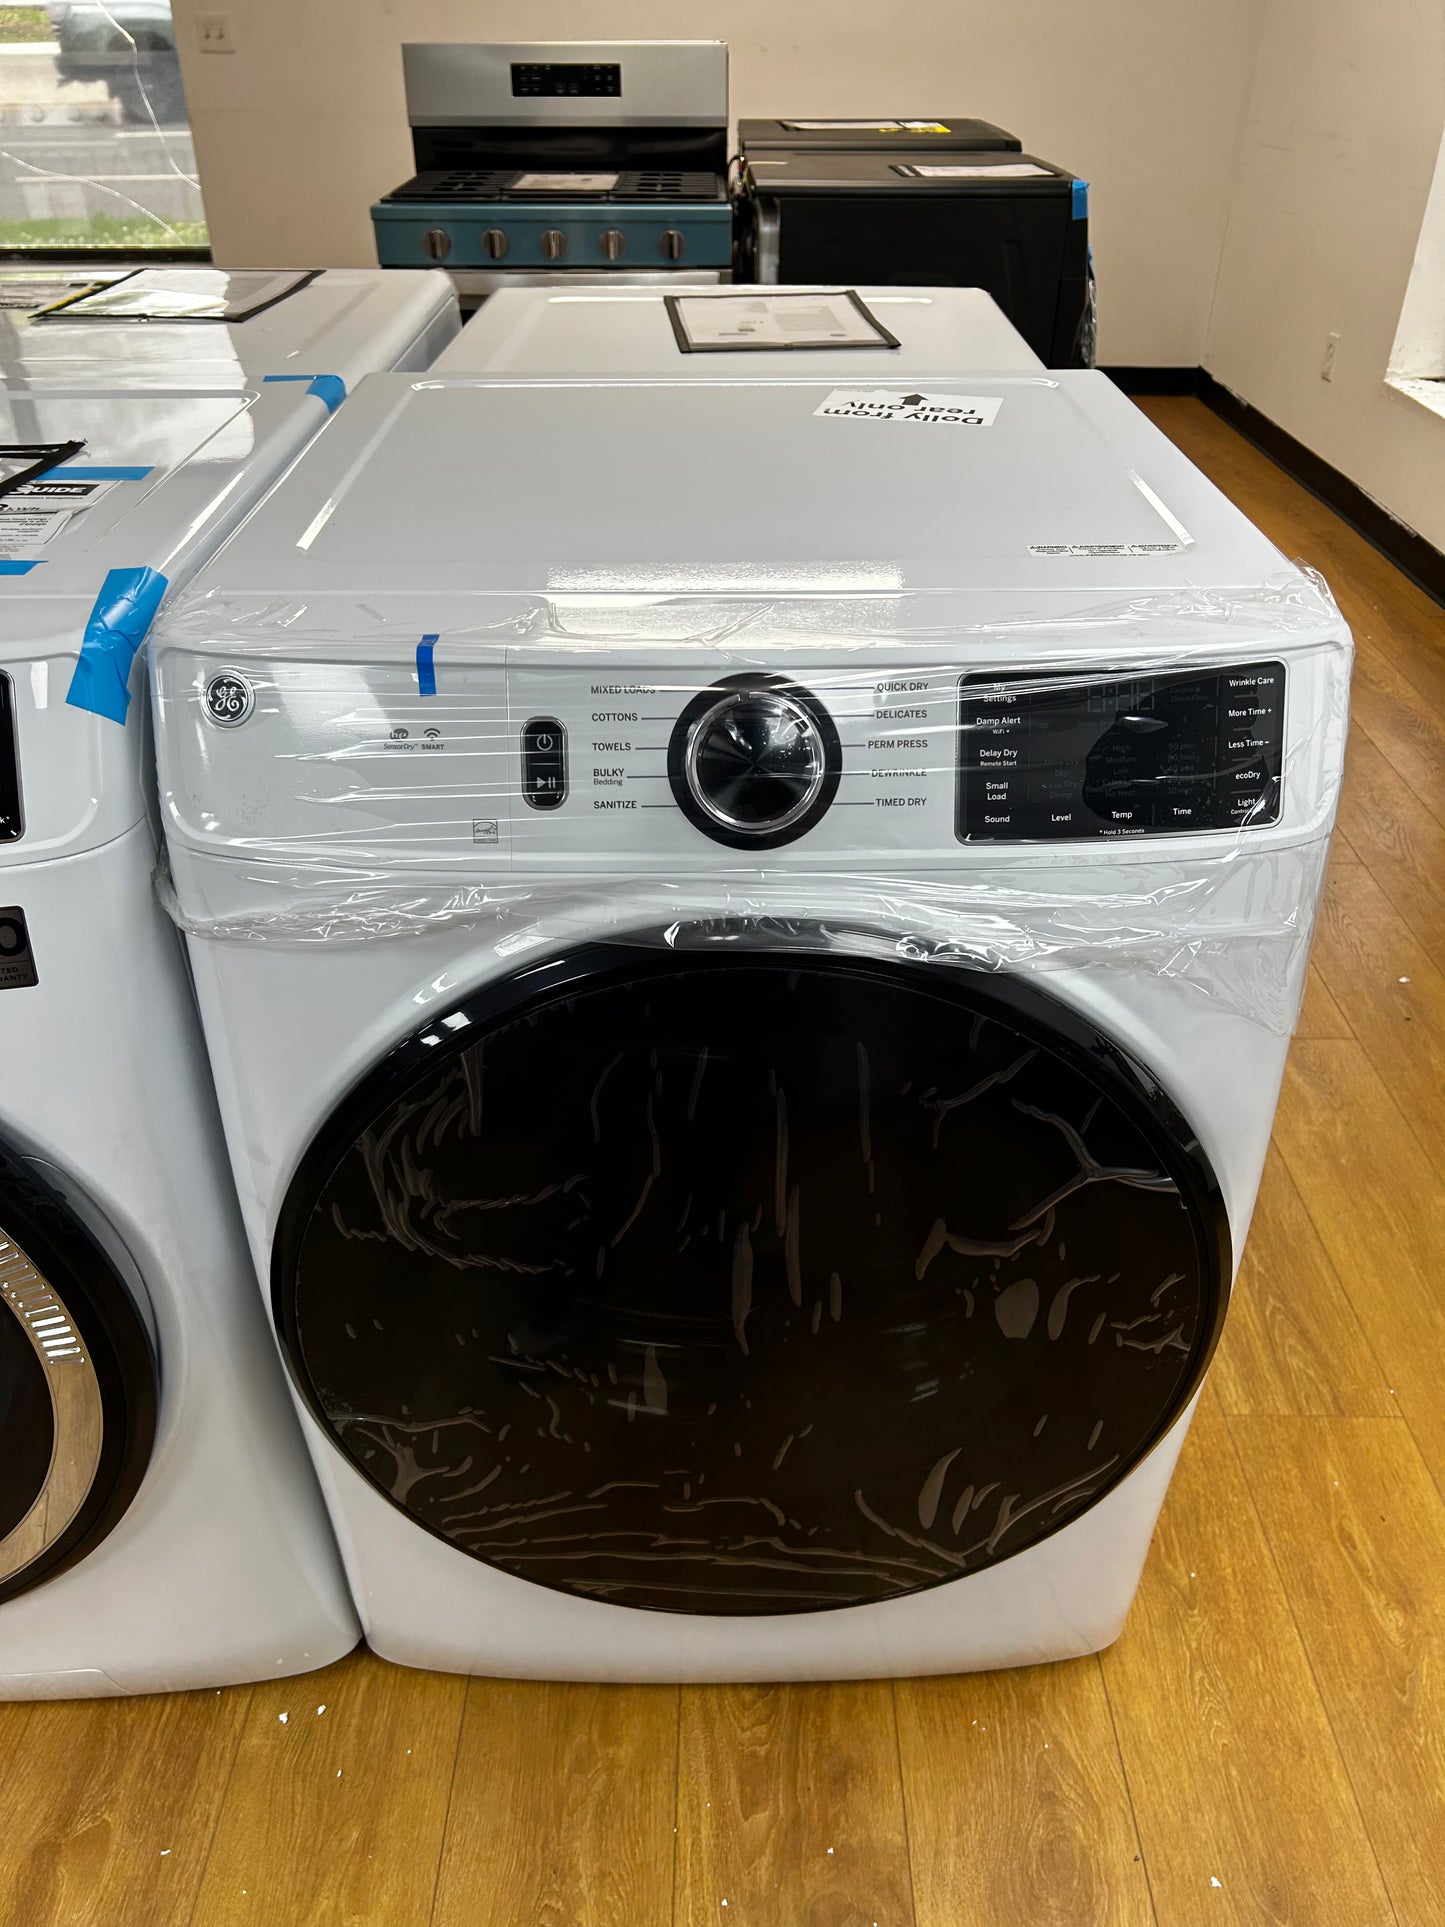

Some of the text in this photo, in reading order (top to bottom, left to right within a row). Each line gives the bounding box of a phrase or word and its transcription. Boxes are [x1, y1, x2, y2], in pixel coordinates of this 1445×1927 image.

[841, 400, 976, 415] rear only
[823, 407, 984, 425] Dolly from
[877, 682, 929, 692] QUICK DRY
[1228, 677, 1275, 688] Wrinkle Care
[590, 685, 621, 694] MIXED
[591, 712, 638, 722] COTTONS
[876, 710, 928, 719] DELICATES
[1228, 710, 1247, 718] More
[1248, 708, 1266, 717] Time
[976, 716, 1021, 726] Damp Alert
[592, 742, 631, 751] TOWELS
[868, 740, 928, 749] PERM PRESS
[1228, 741, 1245, 750] Less
[1246, 740, 1264, 748] Time
[979, 749, 1018, 759] Delay Dry
[593, 768, 624, 777] BULKY
[1235, 771, 1261, 781] ecoDry
[593, 778, 623, 787] Bedding
[985, 782, 1009, 790] Small
[987, 793, 1007, 801] Load
[593, 800, 637, 809] SANITIZE
[875, 798, 927, 807] TIMED DRY
[1237, 799, 1256, 808] Light
[1111, 810, 1133, 819] Temp
[1172, 807, 1193, 816] Time
[984, 815, 1011, 823] Sound
[1051, 813, 1072, 822] Level
